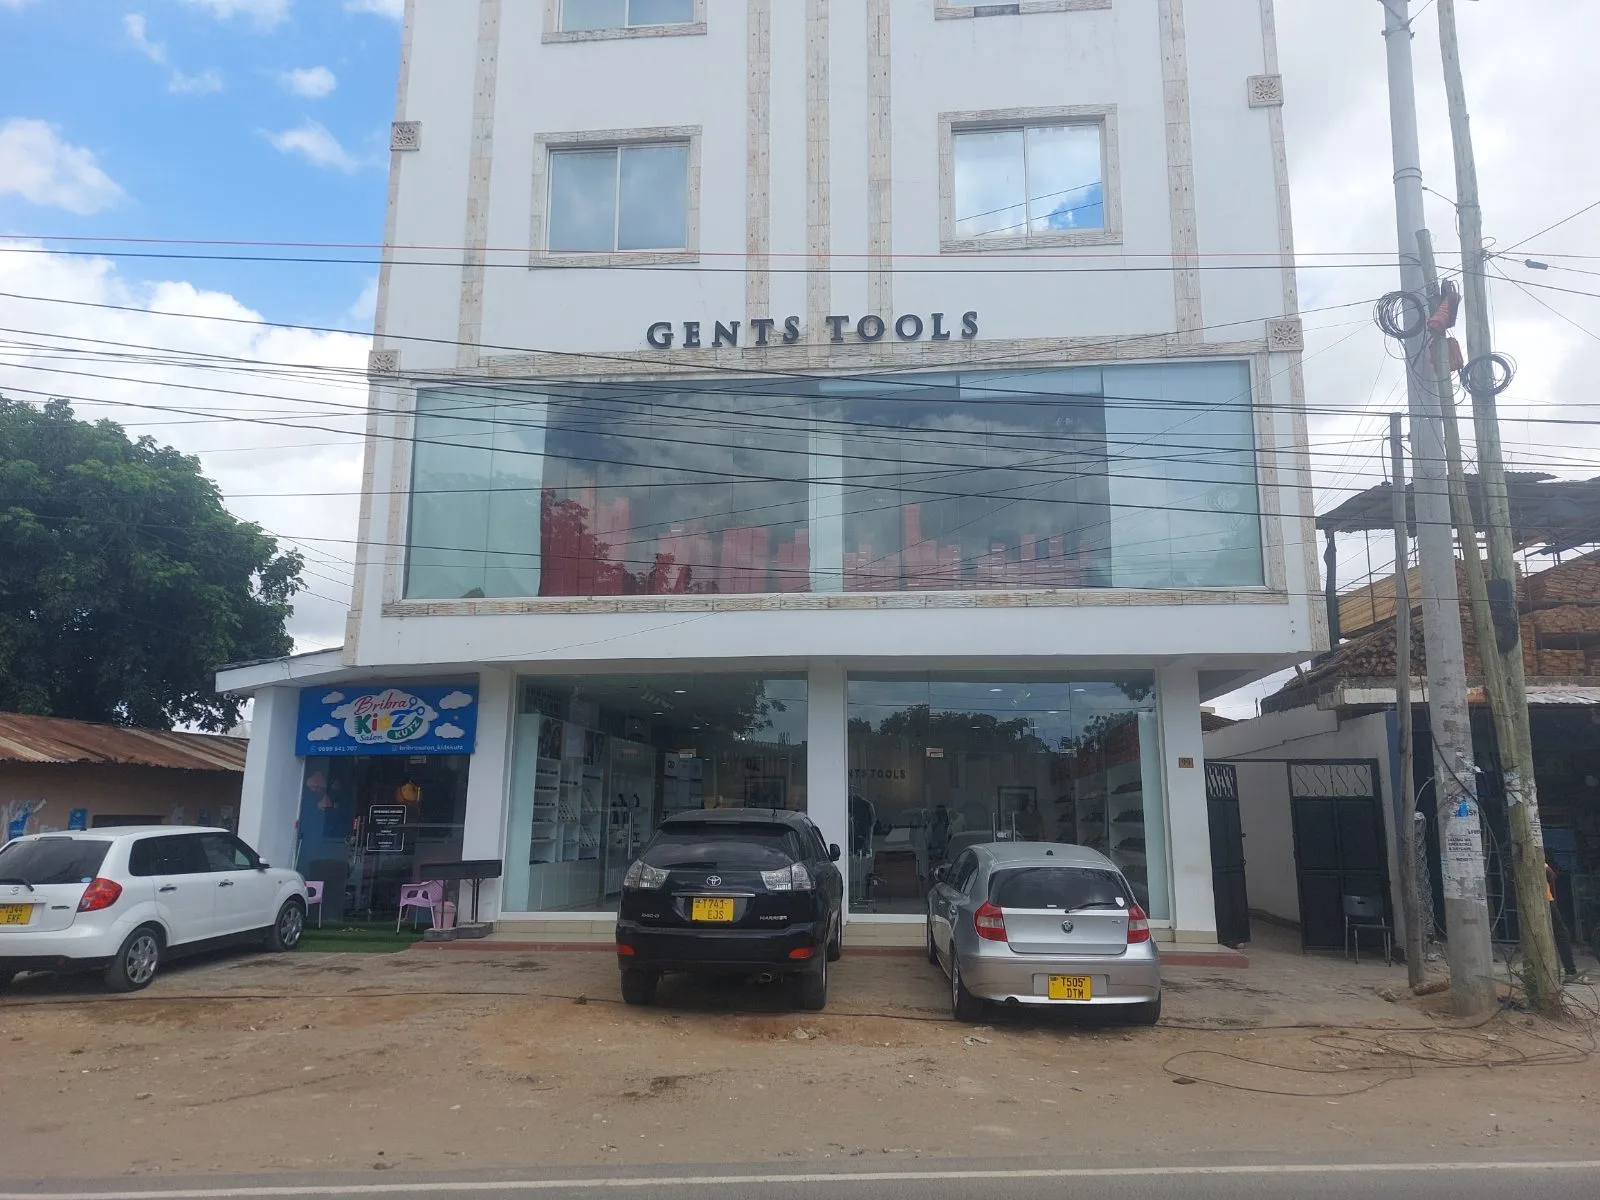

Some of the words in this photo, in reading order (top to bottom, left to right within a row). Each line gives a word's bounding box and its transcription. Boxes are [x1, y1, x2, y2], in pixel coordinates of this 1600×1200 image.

[647, 315, 800, 349] GENTS
[825, 311, 978, 343] TOOLS
[353, 692, 408, 715] Bribra
[359, 733, 384, 742] Salon
[707, 909, 724, 920] EJS
[1061, 977, 1085, 988] T505
[1066, 987, 1085, 999] DTM
